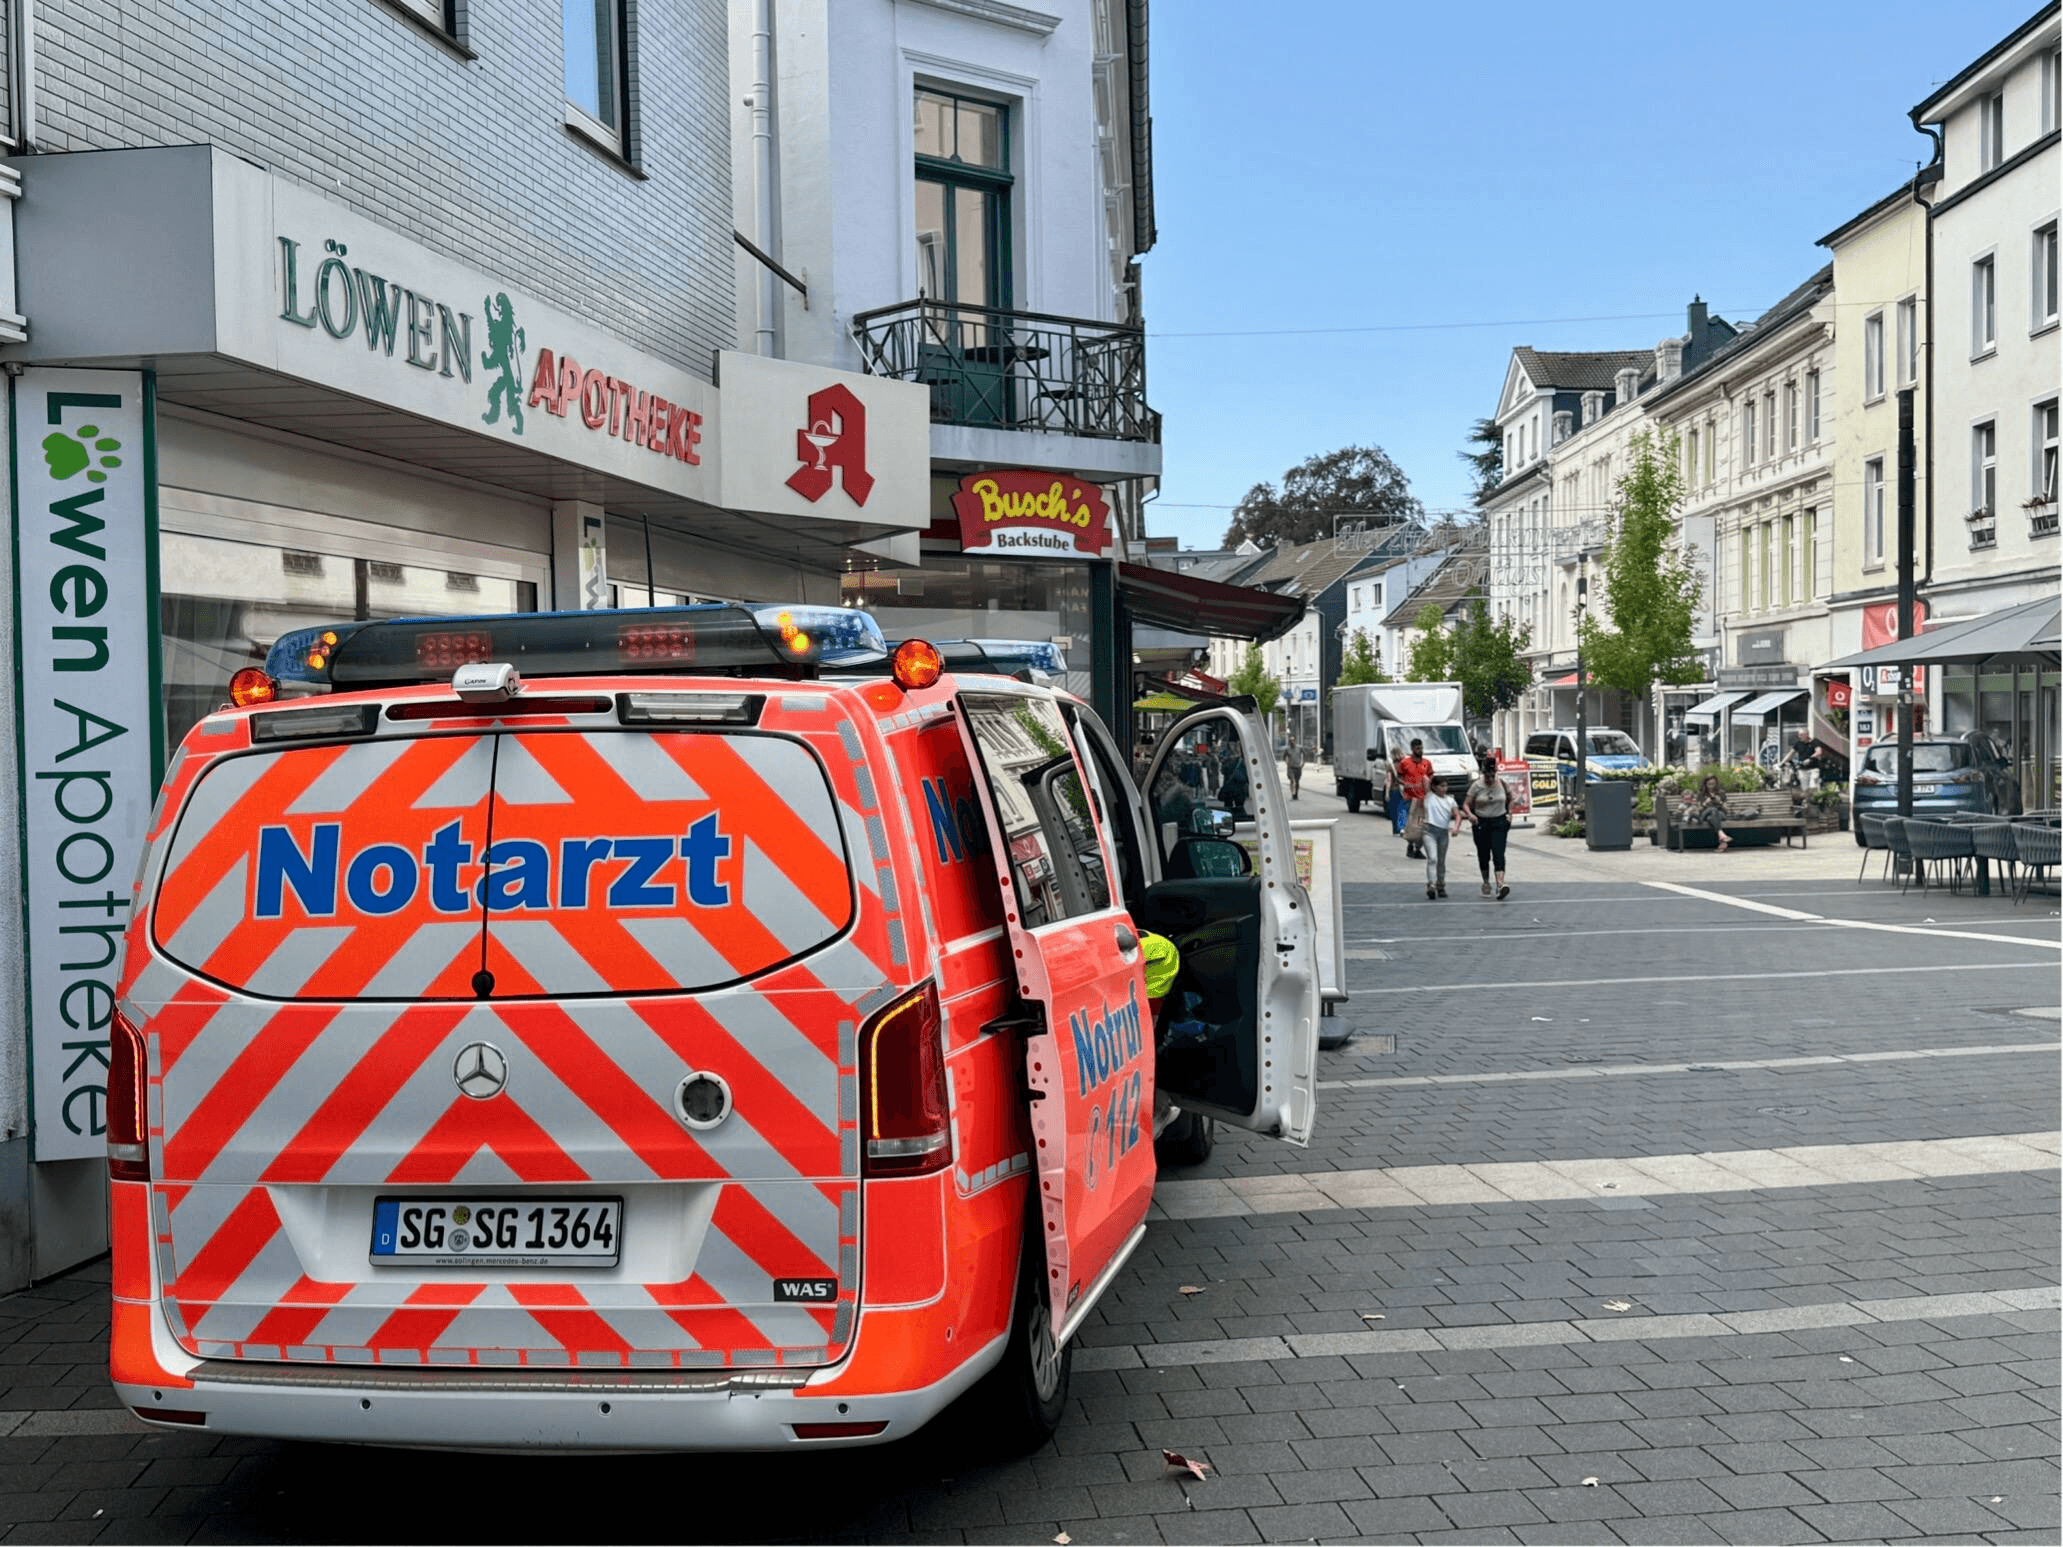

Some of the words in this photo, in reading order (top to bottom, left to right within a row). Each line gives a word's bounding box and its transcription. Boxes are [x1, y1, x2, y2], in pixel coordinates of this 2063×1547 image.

[277, 236, 474, 384] LÖWEN
[529, 347, 704, 466] APOTHEKE
[972, 479, 1091, 527] Busch's
[997, 532, 1070, 550] Backstube
[1532, 780, 1557, 790] GOLD
[255, 809, 732, 920] Notarzt
[35, 698, 130, 1137] Apotheke
[1069, 978, 1143, 1100] Notruf
[1106, 1070, 1141, 1171] 112
[381, 1233, 390, 1245] D
[401, 1208, 446, 1248] SG
[472, 1208, 518, 1248] SG
[525, 1207, 613, 1248] 1364
[782, 1283, 828, 1297] WAS
